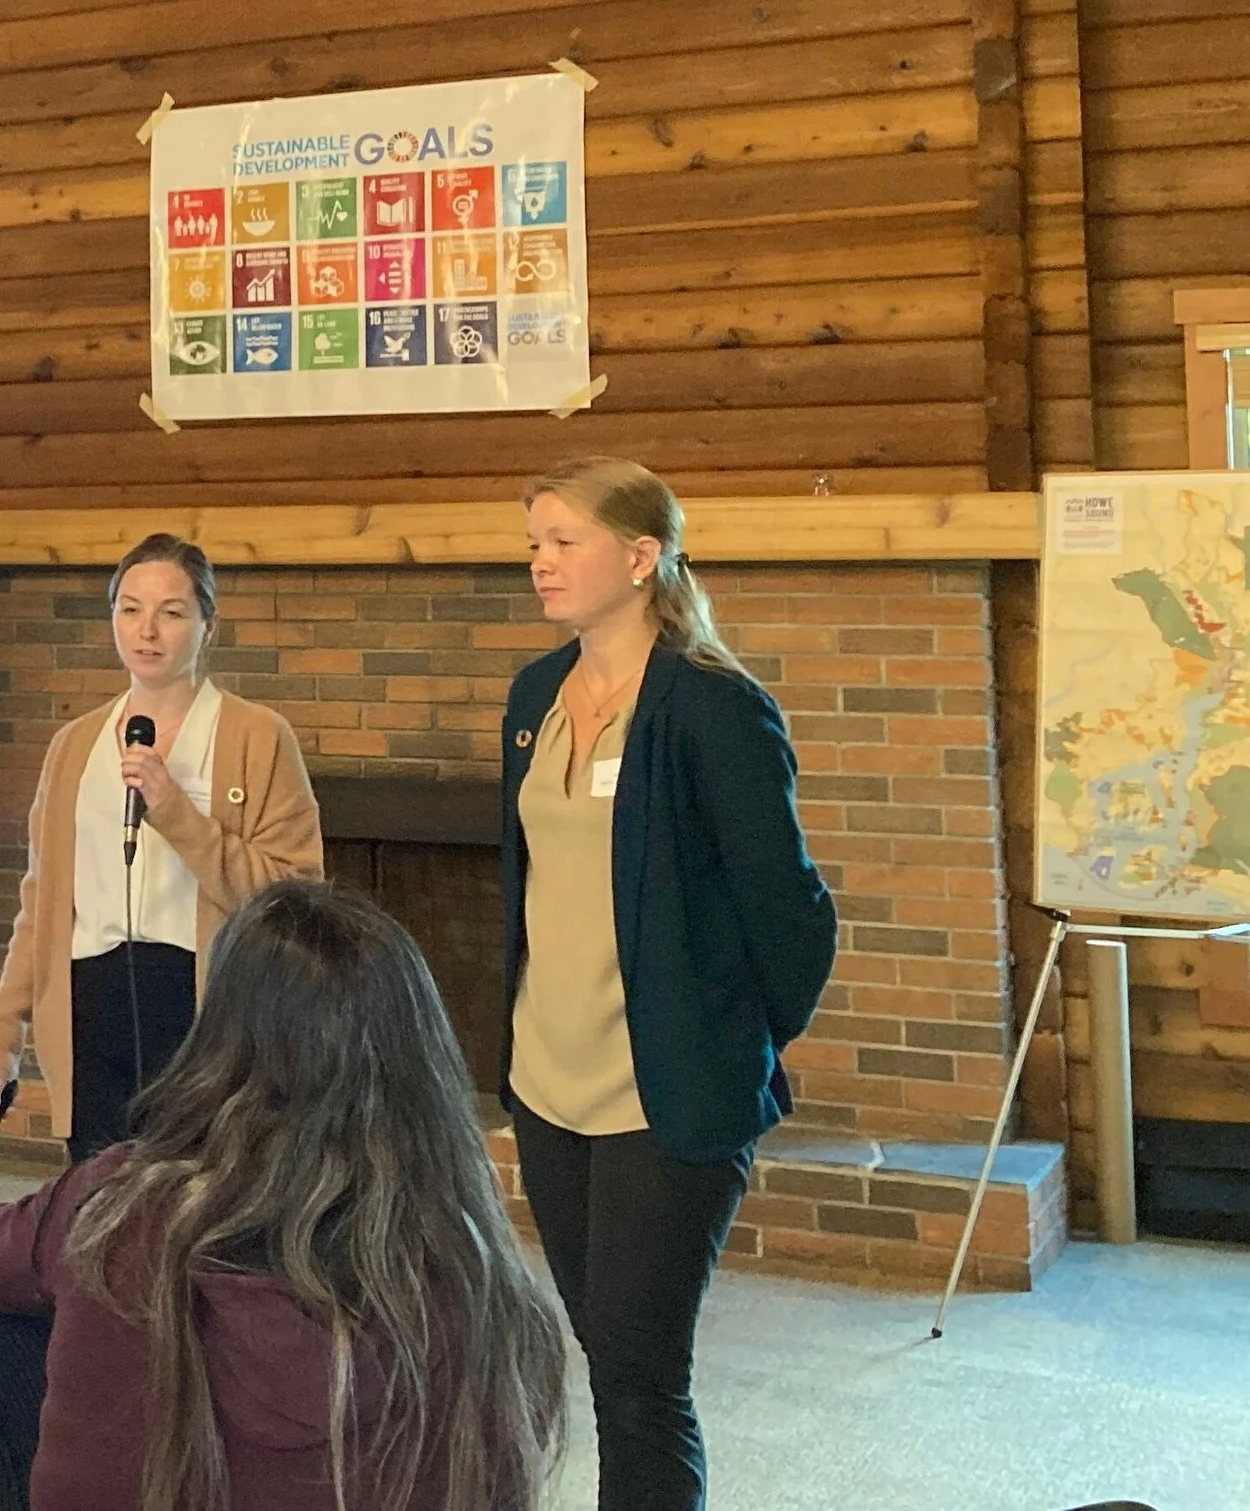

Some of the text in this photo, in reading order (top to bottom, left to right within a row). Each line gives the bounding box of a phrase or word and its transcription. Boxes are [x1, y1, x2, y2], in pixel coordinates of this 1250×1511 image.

[232, 134, 350, 159] SUSTAINABLE
[354, 123, 494, 166] GOALS
[233, 153, 350, 177] DEVELOPMENT
[368, 179, 376, 194] 4
[368, 244, 381, 260] 10
[438, 307, 450, 322] 17
[236, 317, 248, 332] 14
